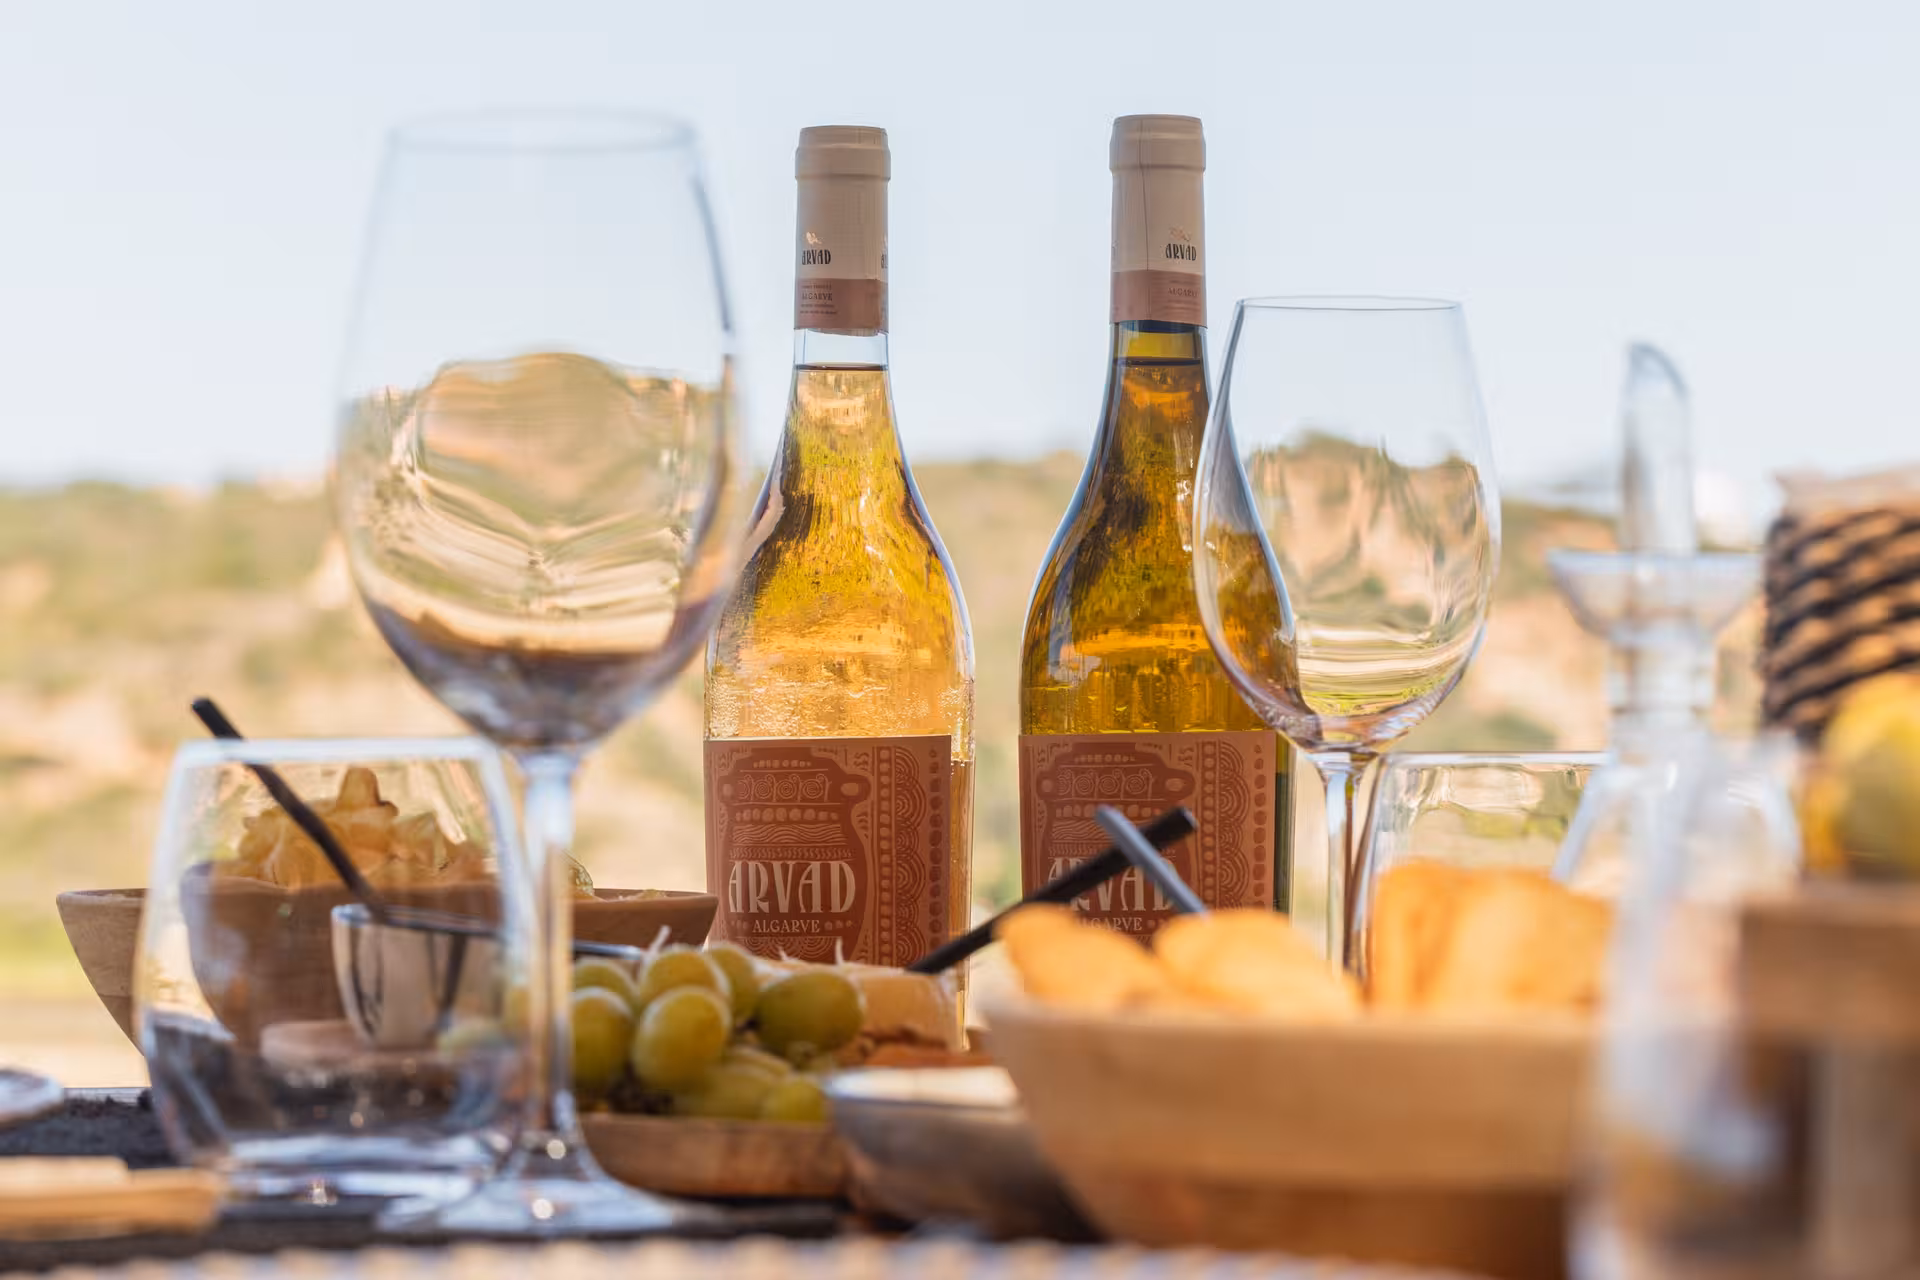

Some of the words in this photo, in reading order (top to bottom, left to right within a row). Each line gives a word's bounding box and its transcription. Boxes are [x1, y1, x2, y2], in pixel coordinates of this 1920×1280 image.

[802, 249, 832, 265] ARVAD
[1165, 243, 1197, 261] ARVAD
[728, 860, 856, 913] ARVAD
[752, 919, 820, 933] ALGARVE
[1075, 917, 1143, 931] LGARVE
